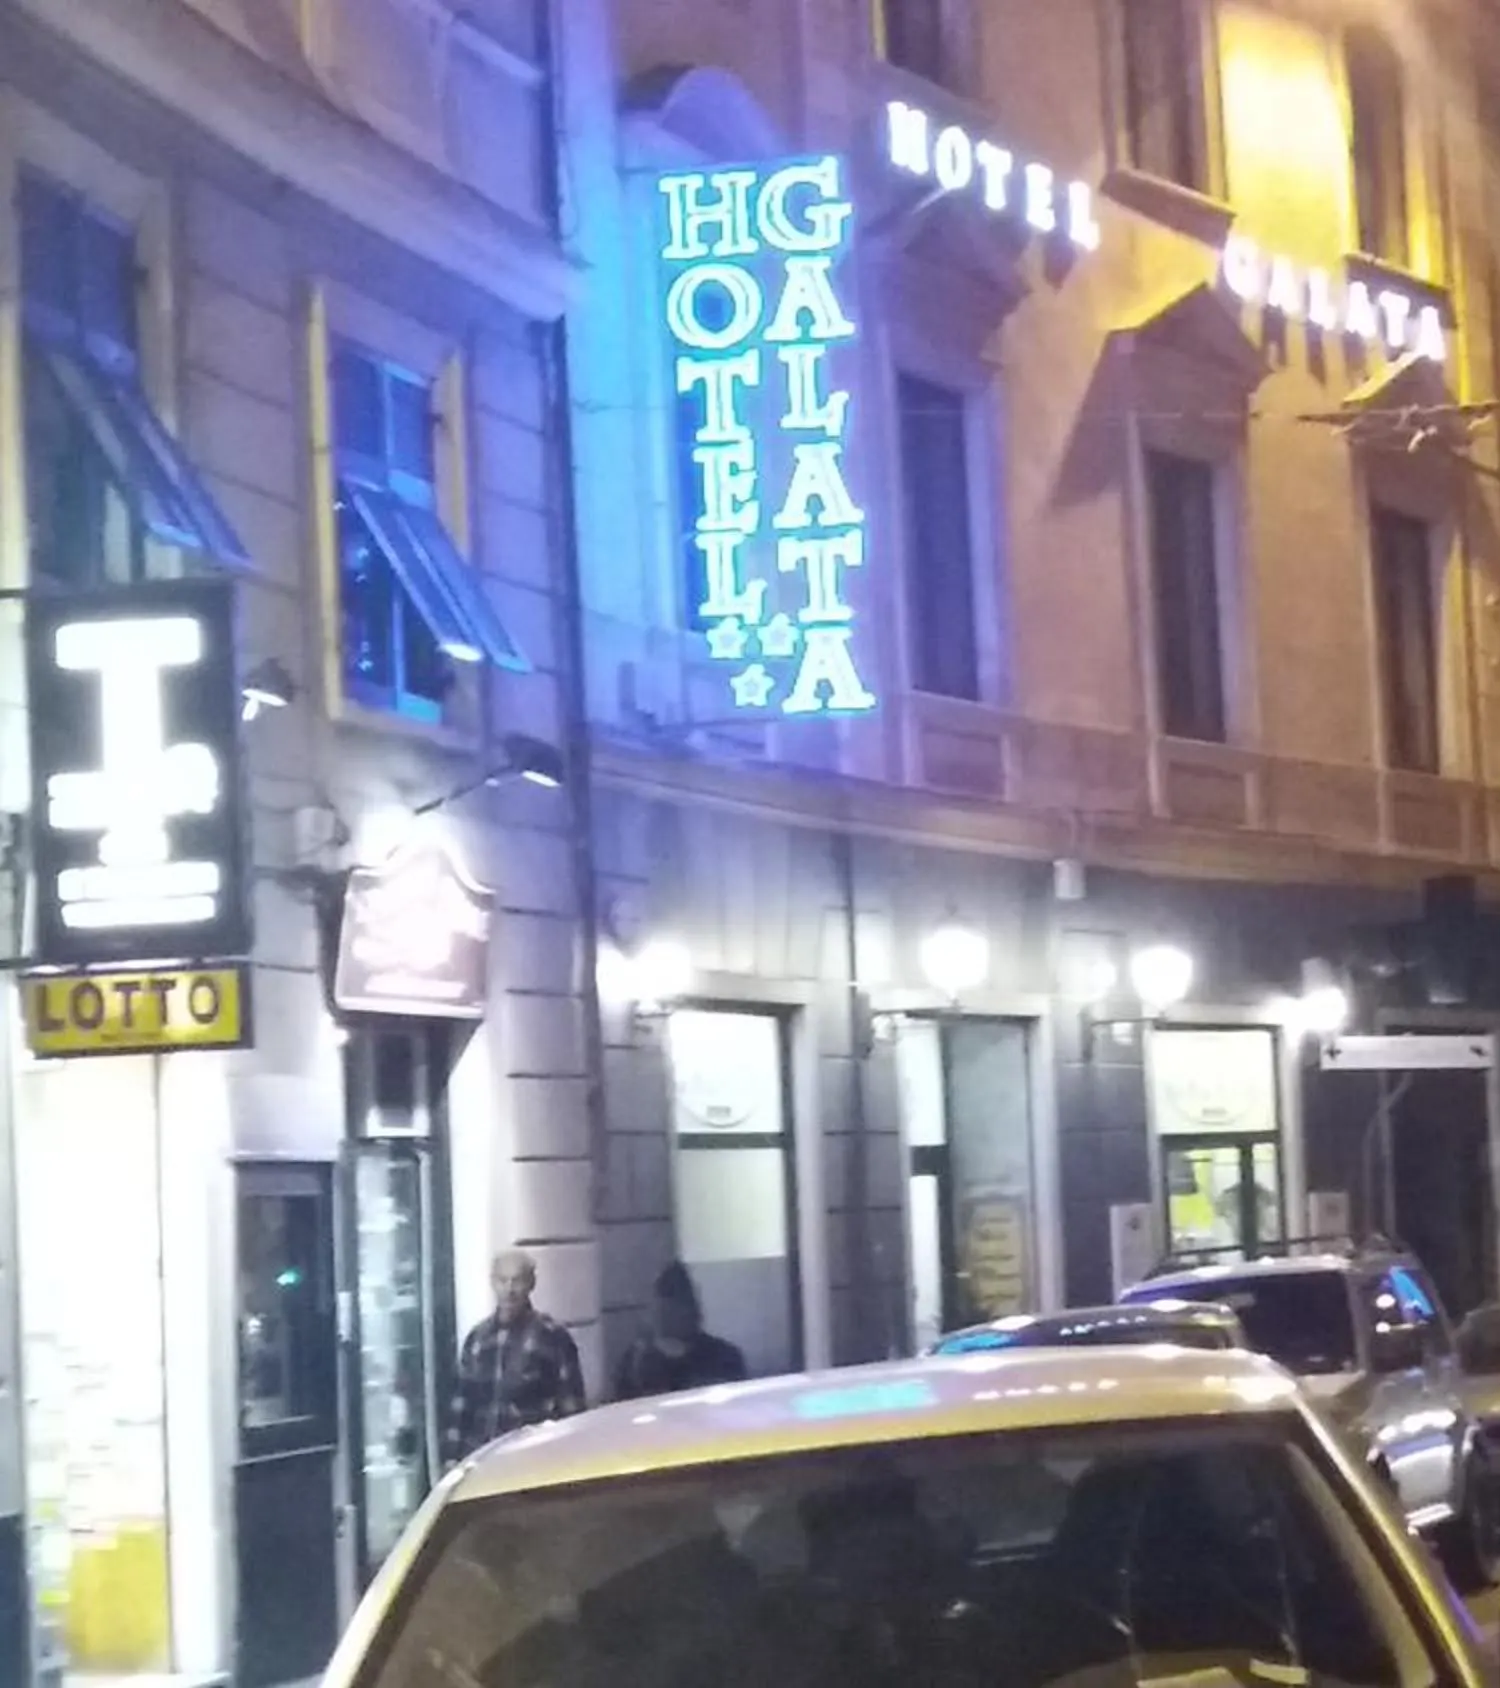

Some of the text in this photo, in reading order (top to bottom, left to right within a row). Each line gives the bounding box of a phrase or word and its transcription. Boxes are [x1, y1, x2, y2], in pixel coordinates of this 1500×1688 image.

[659, 170, 766, 622] HOTEL
[887, 101, 1447, 361] HOTEL GALATA
[757, 157, 875, 713] GALATA
[36, 976, 221, 1033] LOTTO
